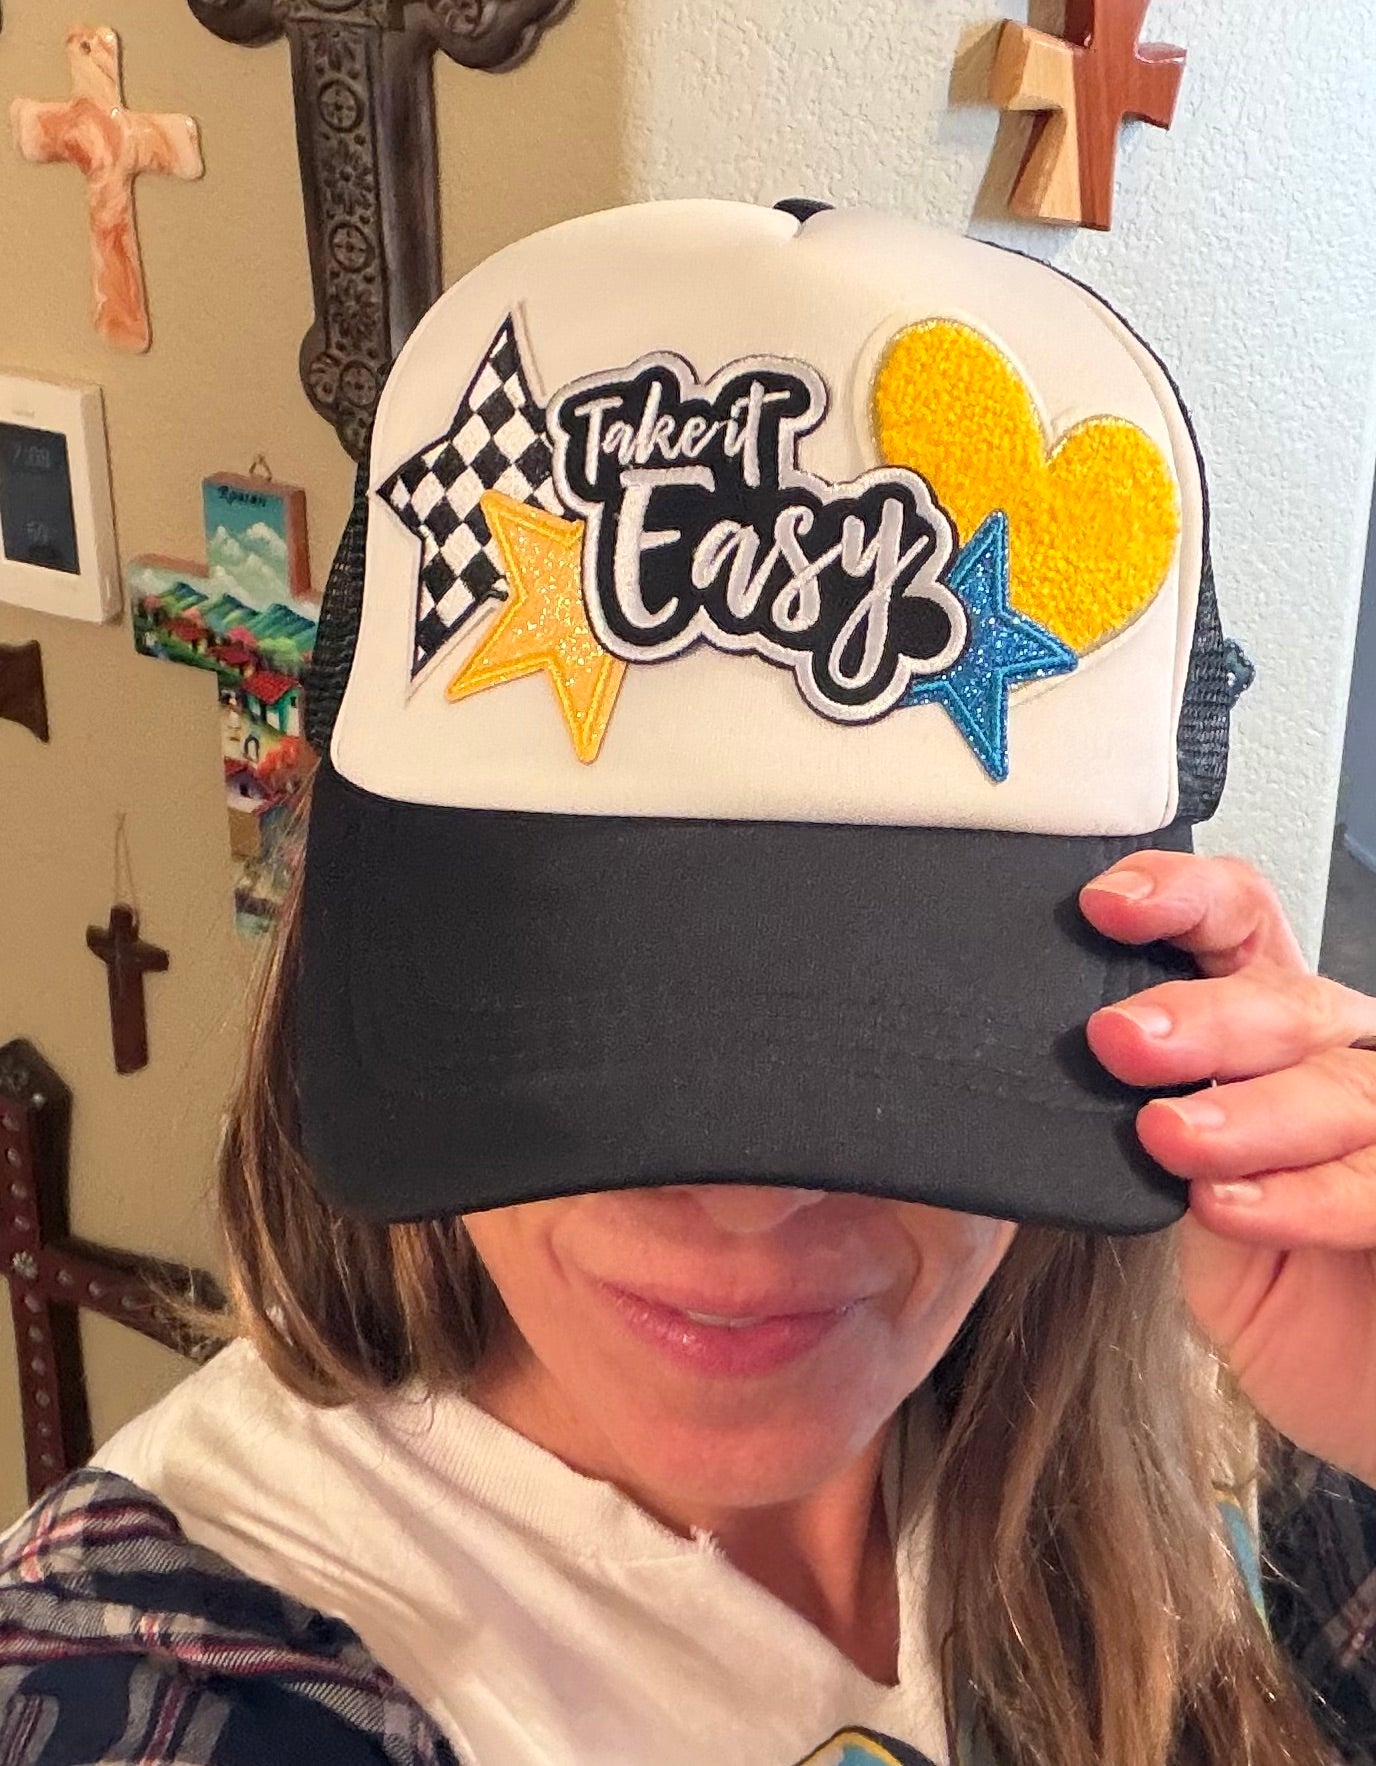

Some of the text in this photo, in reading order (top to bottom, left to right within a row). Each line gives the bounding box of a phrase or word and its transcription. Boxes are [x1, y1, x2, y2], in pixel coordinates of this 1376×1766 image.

[574, 379, 791, 488] Take it
[613, 466, 930, 689] Easy
